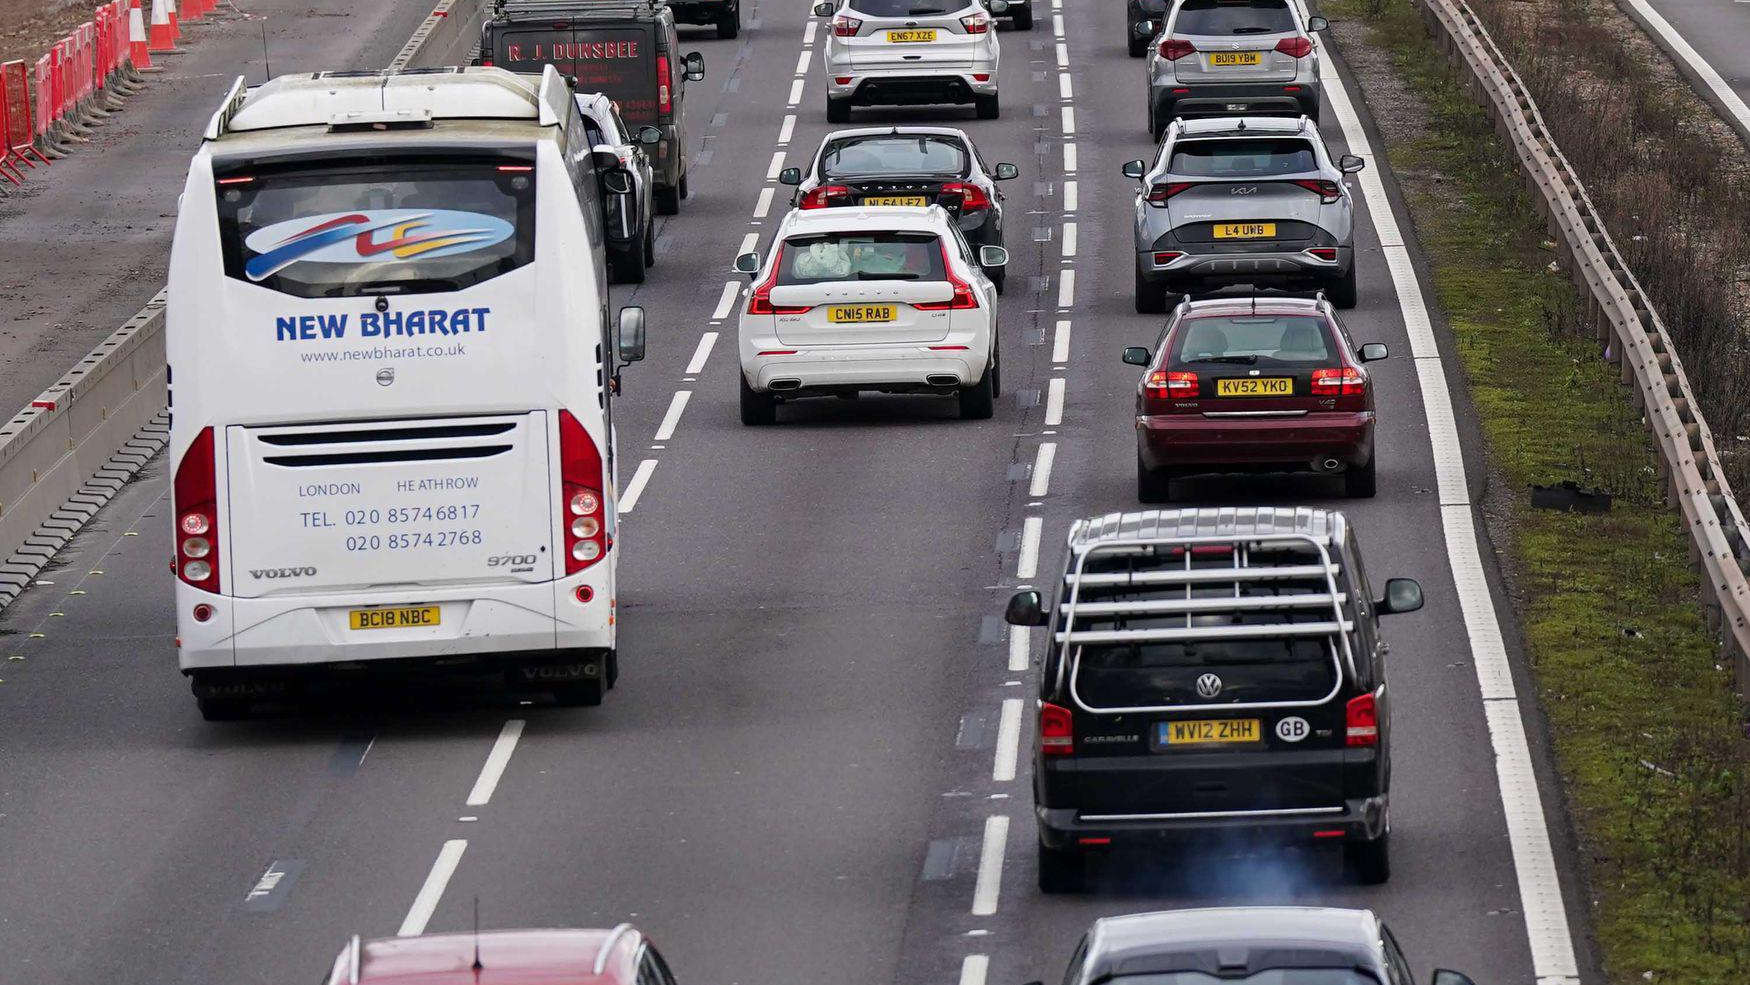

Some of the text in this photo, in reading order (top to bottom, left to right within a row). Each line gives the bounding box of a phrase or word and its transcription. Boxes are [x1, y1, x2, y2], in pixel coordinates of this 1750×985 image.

[891, 30, 933, 41] EN67 XZE
[553, 40, 640, 61] DUNSBEE
[1215, 53, 1256, 64] BU19 YBM
[1225, 226, 1240, 236] L4
[835, 307, 890, 320] CN15 RAB
[276, 307, 491, 341] NEW BHARAT
[301, 343, 466, 363] www.newbharat.co.uk
[1223, 379, 1288, 393] KV52 YKO
[299, 482, 361, 497] LONDON
[300, 512, 336, 528] TEL.
[345, 509, 380, 526] 020
[346, 536, 380, 551] 020
[487, 554, 537, 567] 9700
[249, 566, 318, 580] VOLVO
[359, 609, 431, 627] BC18 NBC
[1175, 721, 1252, 740] WV12 ZHH
[1279, 721, 1306, 737] GB
